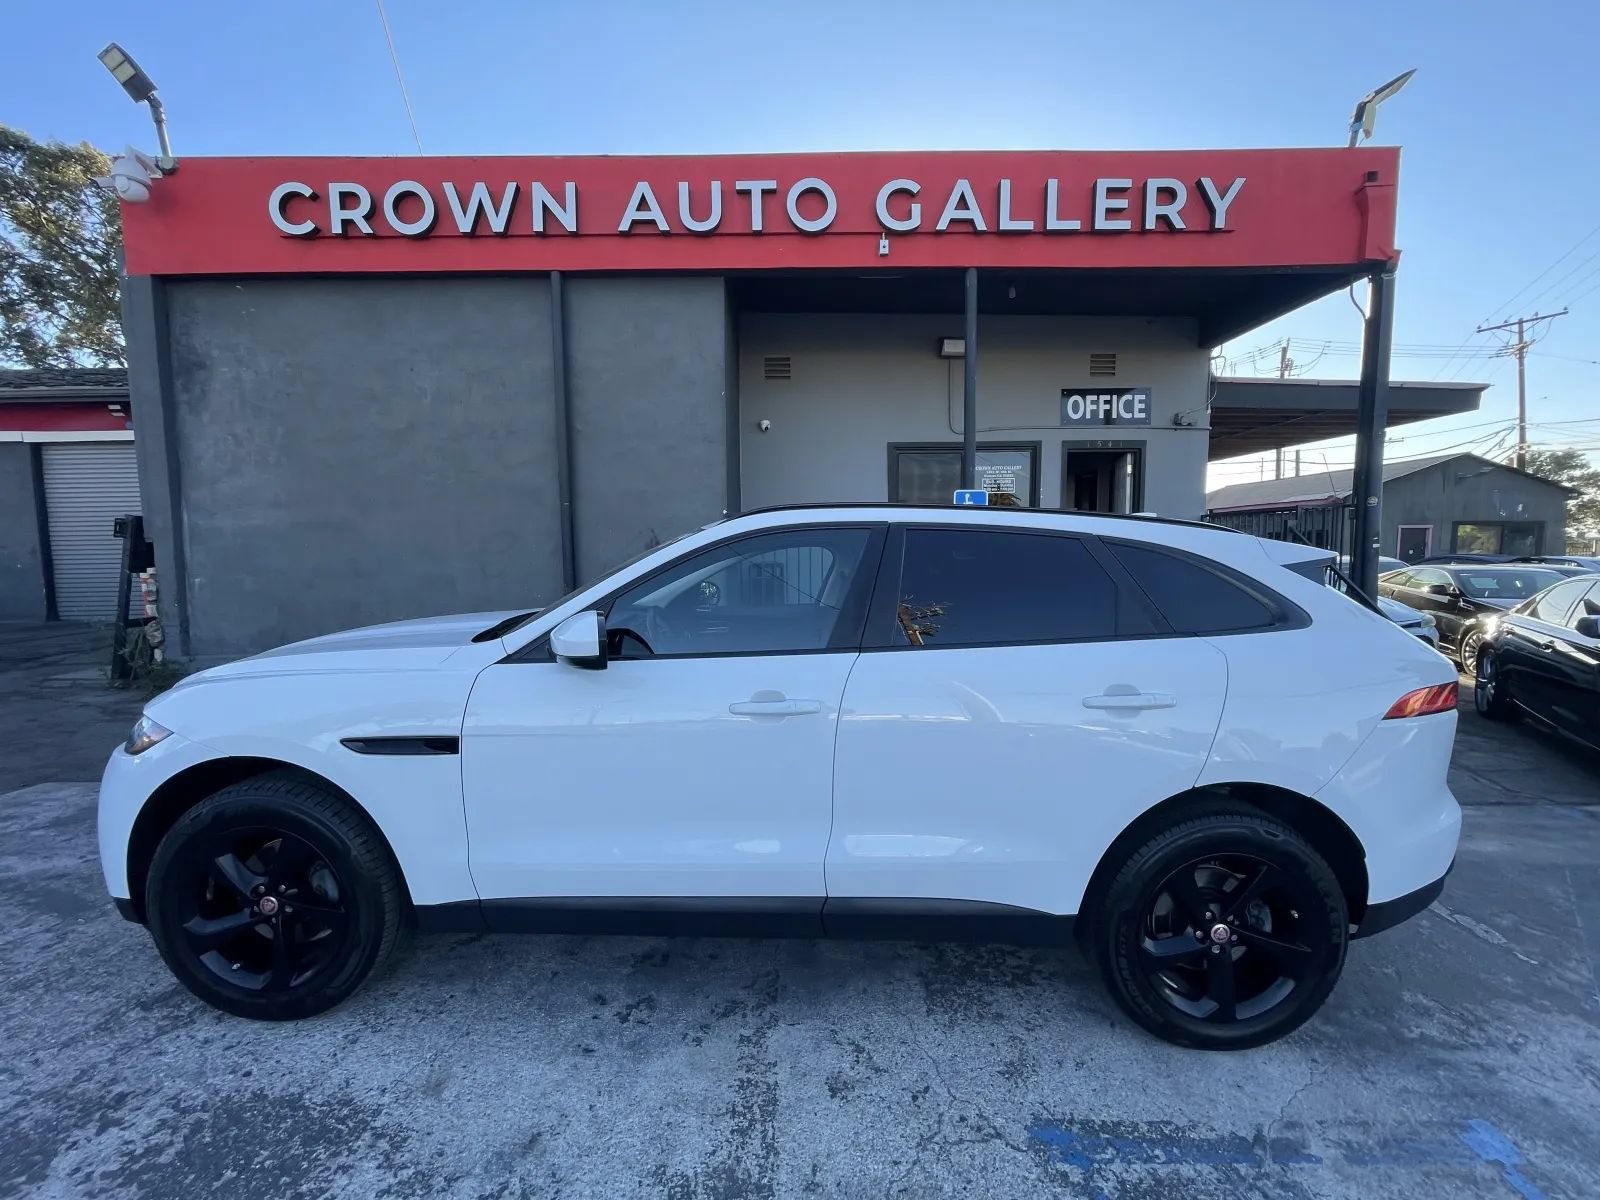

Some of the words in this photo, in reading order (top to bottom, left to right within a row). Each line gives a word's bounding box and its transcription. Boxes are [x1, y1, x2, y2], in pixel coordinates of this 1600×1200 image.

[268, 179, 578, 236] CROWN
[617, 176, 838, 233] AUTO
[875, 176, 1247, 233] GALLERY
[1066, 394, 1146, 420] OFFICE
